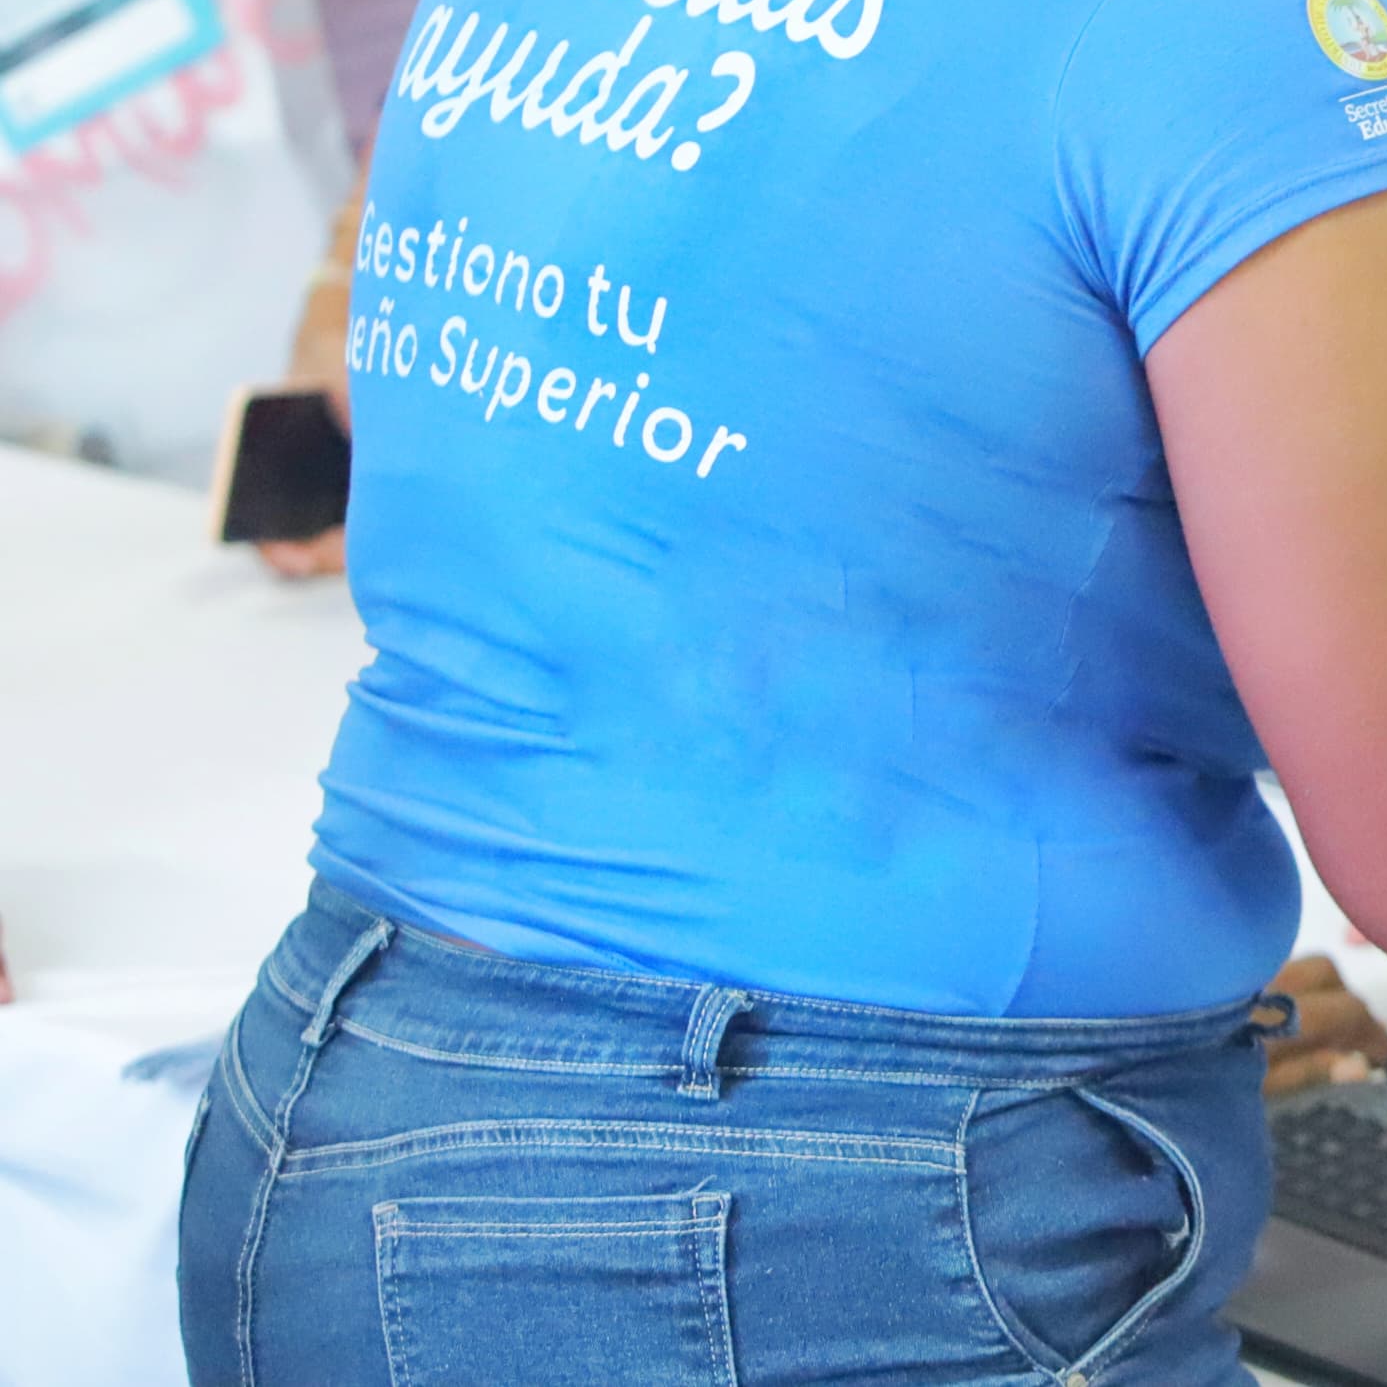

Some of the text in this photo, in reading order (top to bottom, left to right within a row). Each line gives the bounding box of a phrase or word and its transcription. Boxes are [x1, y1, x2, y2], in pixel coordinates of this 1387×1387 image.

[397, 3, 757, 172] ayuda?
[356, 199, 668, 355] Gestiono tu
[429, 315, 748, 479] Superior
